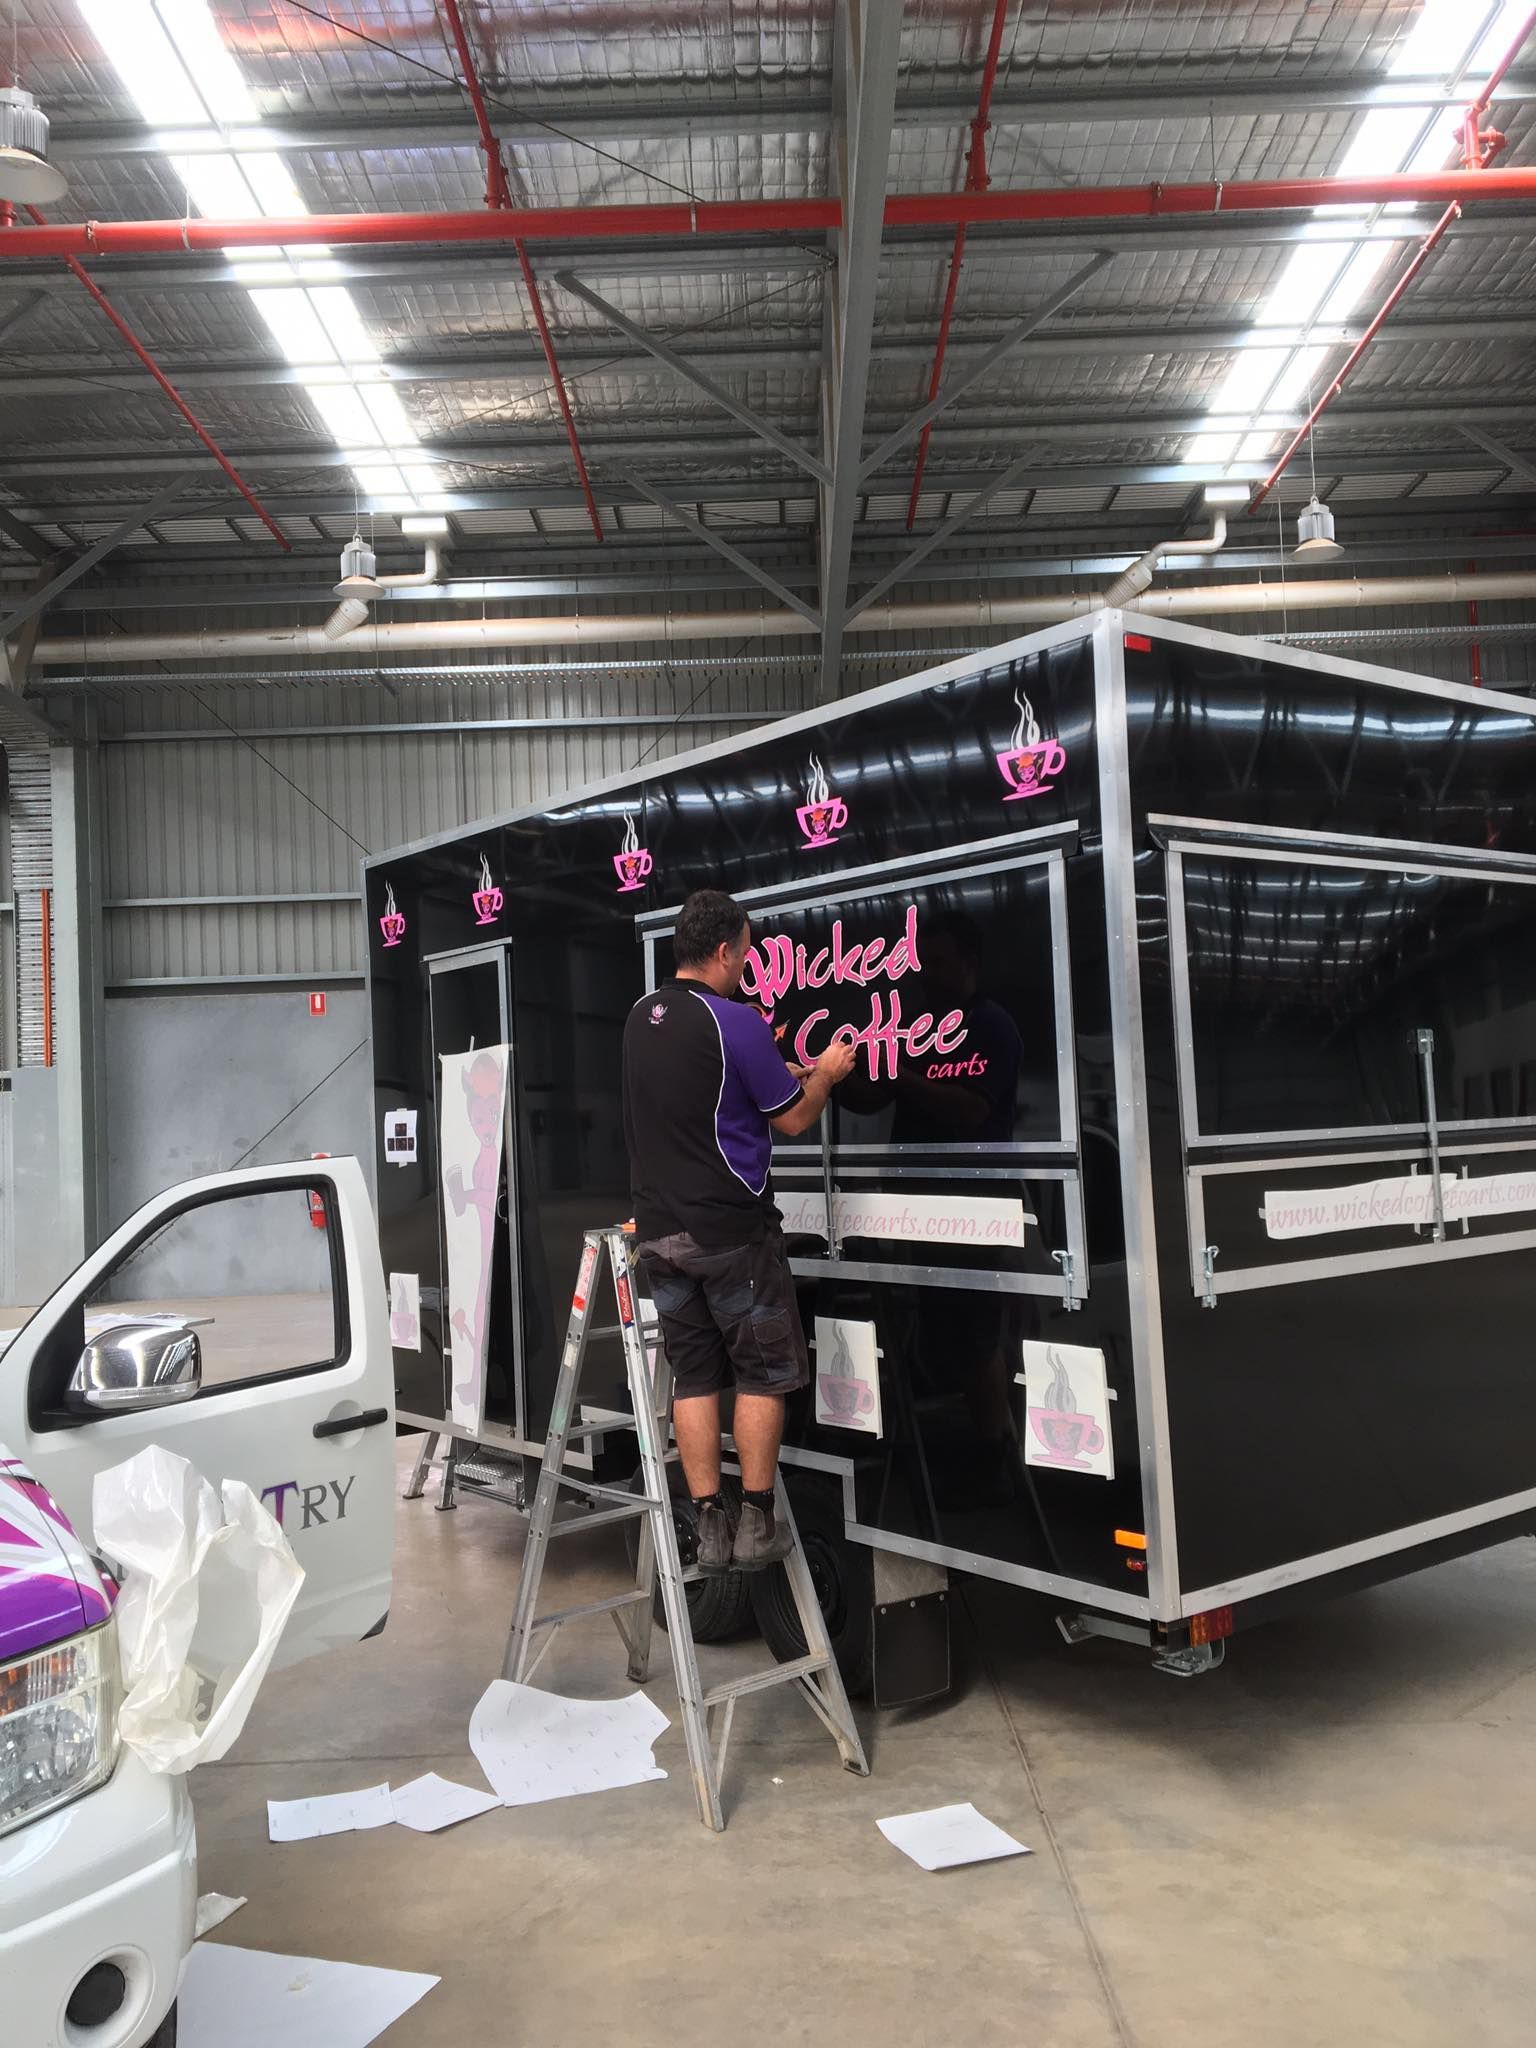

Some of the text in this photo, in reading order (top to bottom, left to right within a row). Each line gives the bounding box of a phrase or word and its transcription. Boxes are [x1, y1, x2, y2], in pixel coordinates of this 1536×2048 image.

[739, 904, 922, 1007] Wicked
[794, 989, 968, 1081] Coffee
[926, 1053, 988, 1079] carts
